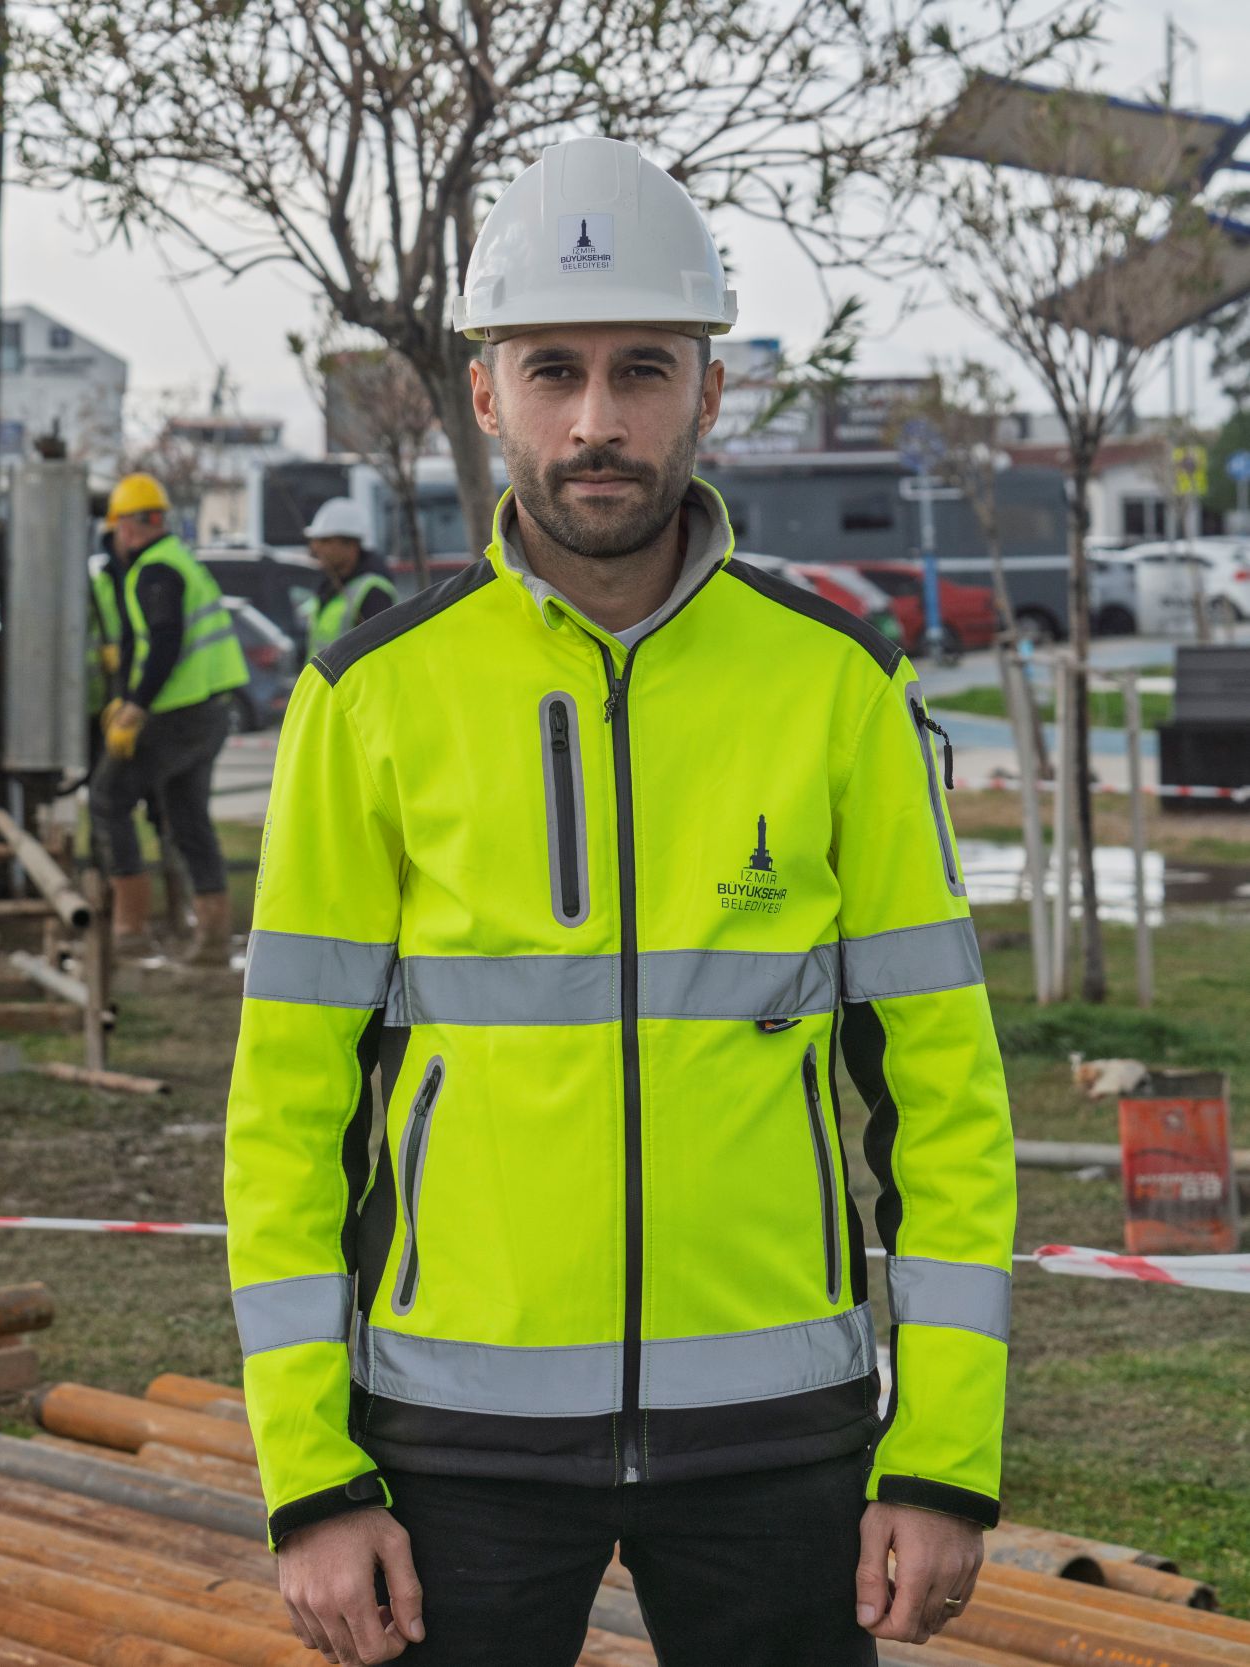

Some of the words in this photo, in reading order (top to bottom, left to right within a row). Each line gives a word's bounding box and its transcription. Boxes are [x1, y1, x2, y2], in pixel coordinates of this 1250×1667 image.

[562, 261, 609, 270] BELEDİYESİ
[717, 881, 787, 900] BÜYÜKŞEHİR
[721, 897, 782, 914] BELEDİYESİ
